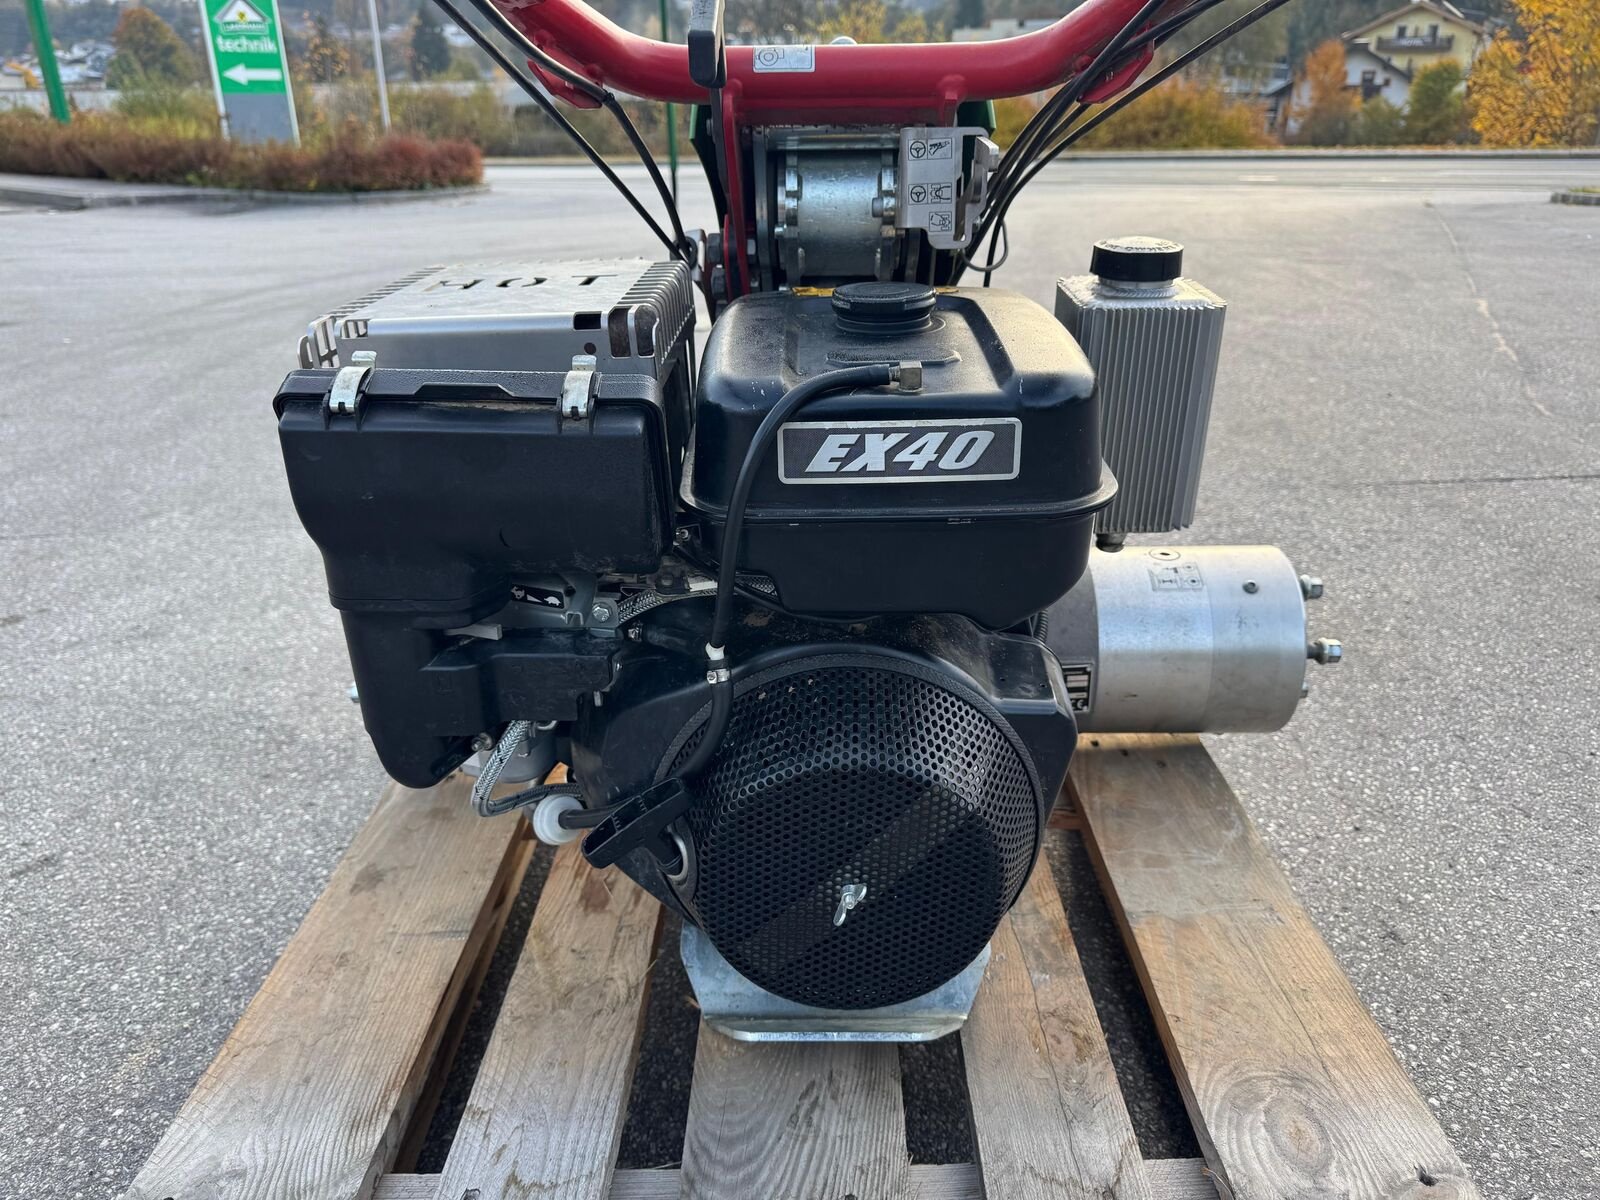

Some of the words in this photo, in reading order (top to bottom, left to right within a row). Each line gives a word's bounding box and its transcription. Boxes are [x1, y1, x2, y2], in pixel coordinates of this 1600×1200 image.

[216, 35, 277, 54] technik
[423, 274, 619, 292] HOT
[804, 430, 996, 473] EX40
